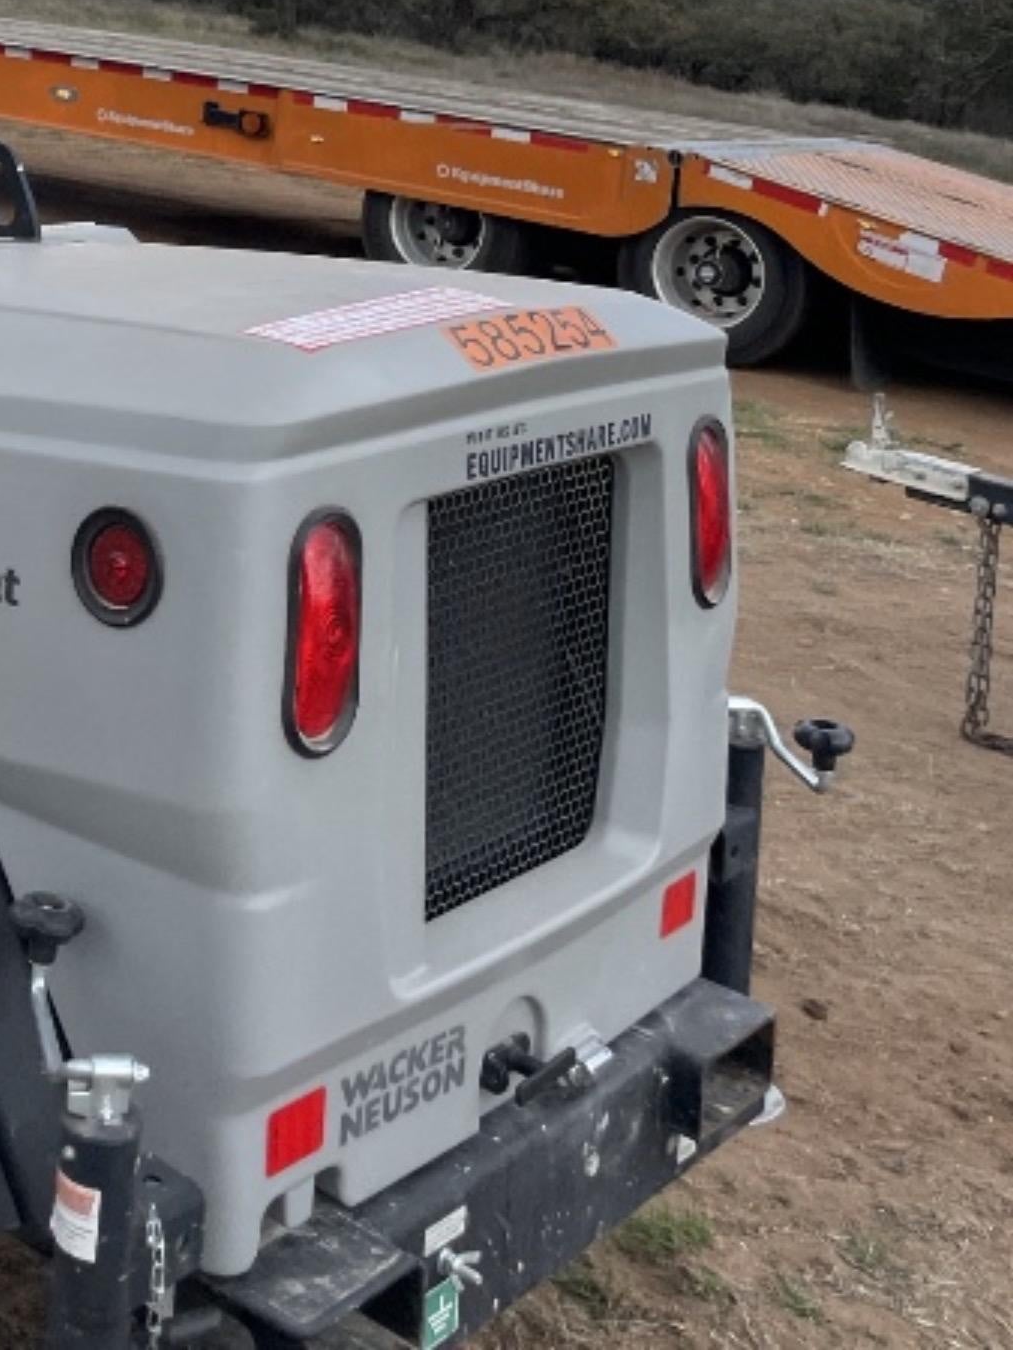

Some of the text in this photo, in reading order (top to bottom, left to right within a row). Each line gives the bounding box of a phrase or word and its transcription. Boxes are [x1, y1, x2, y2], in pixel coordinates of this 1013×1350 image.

[449, 306, 614, 367] 585254
[466, 413, 652, 480] EQUIPMENTSHARE.COM
[340, 1056, 465, 1147] NEUSON
[341, 1025, 465, 1108] WACKER
